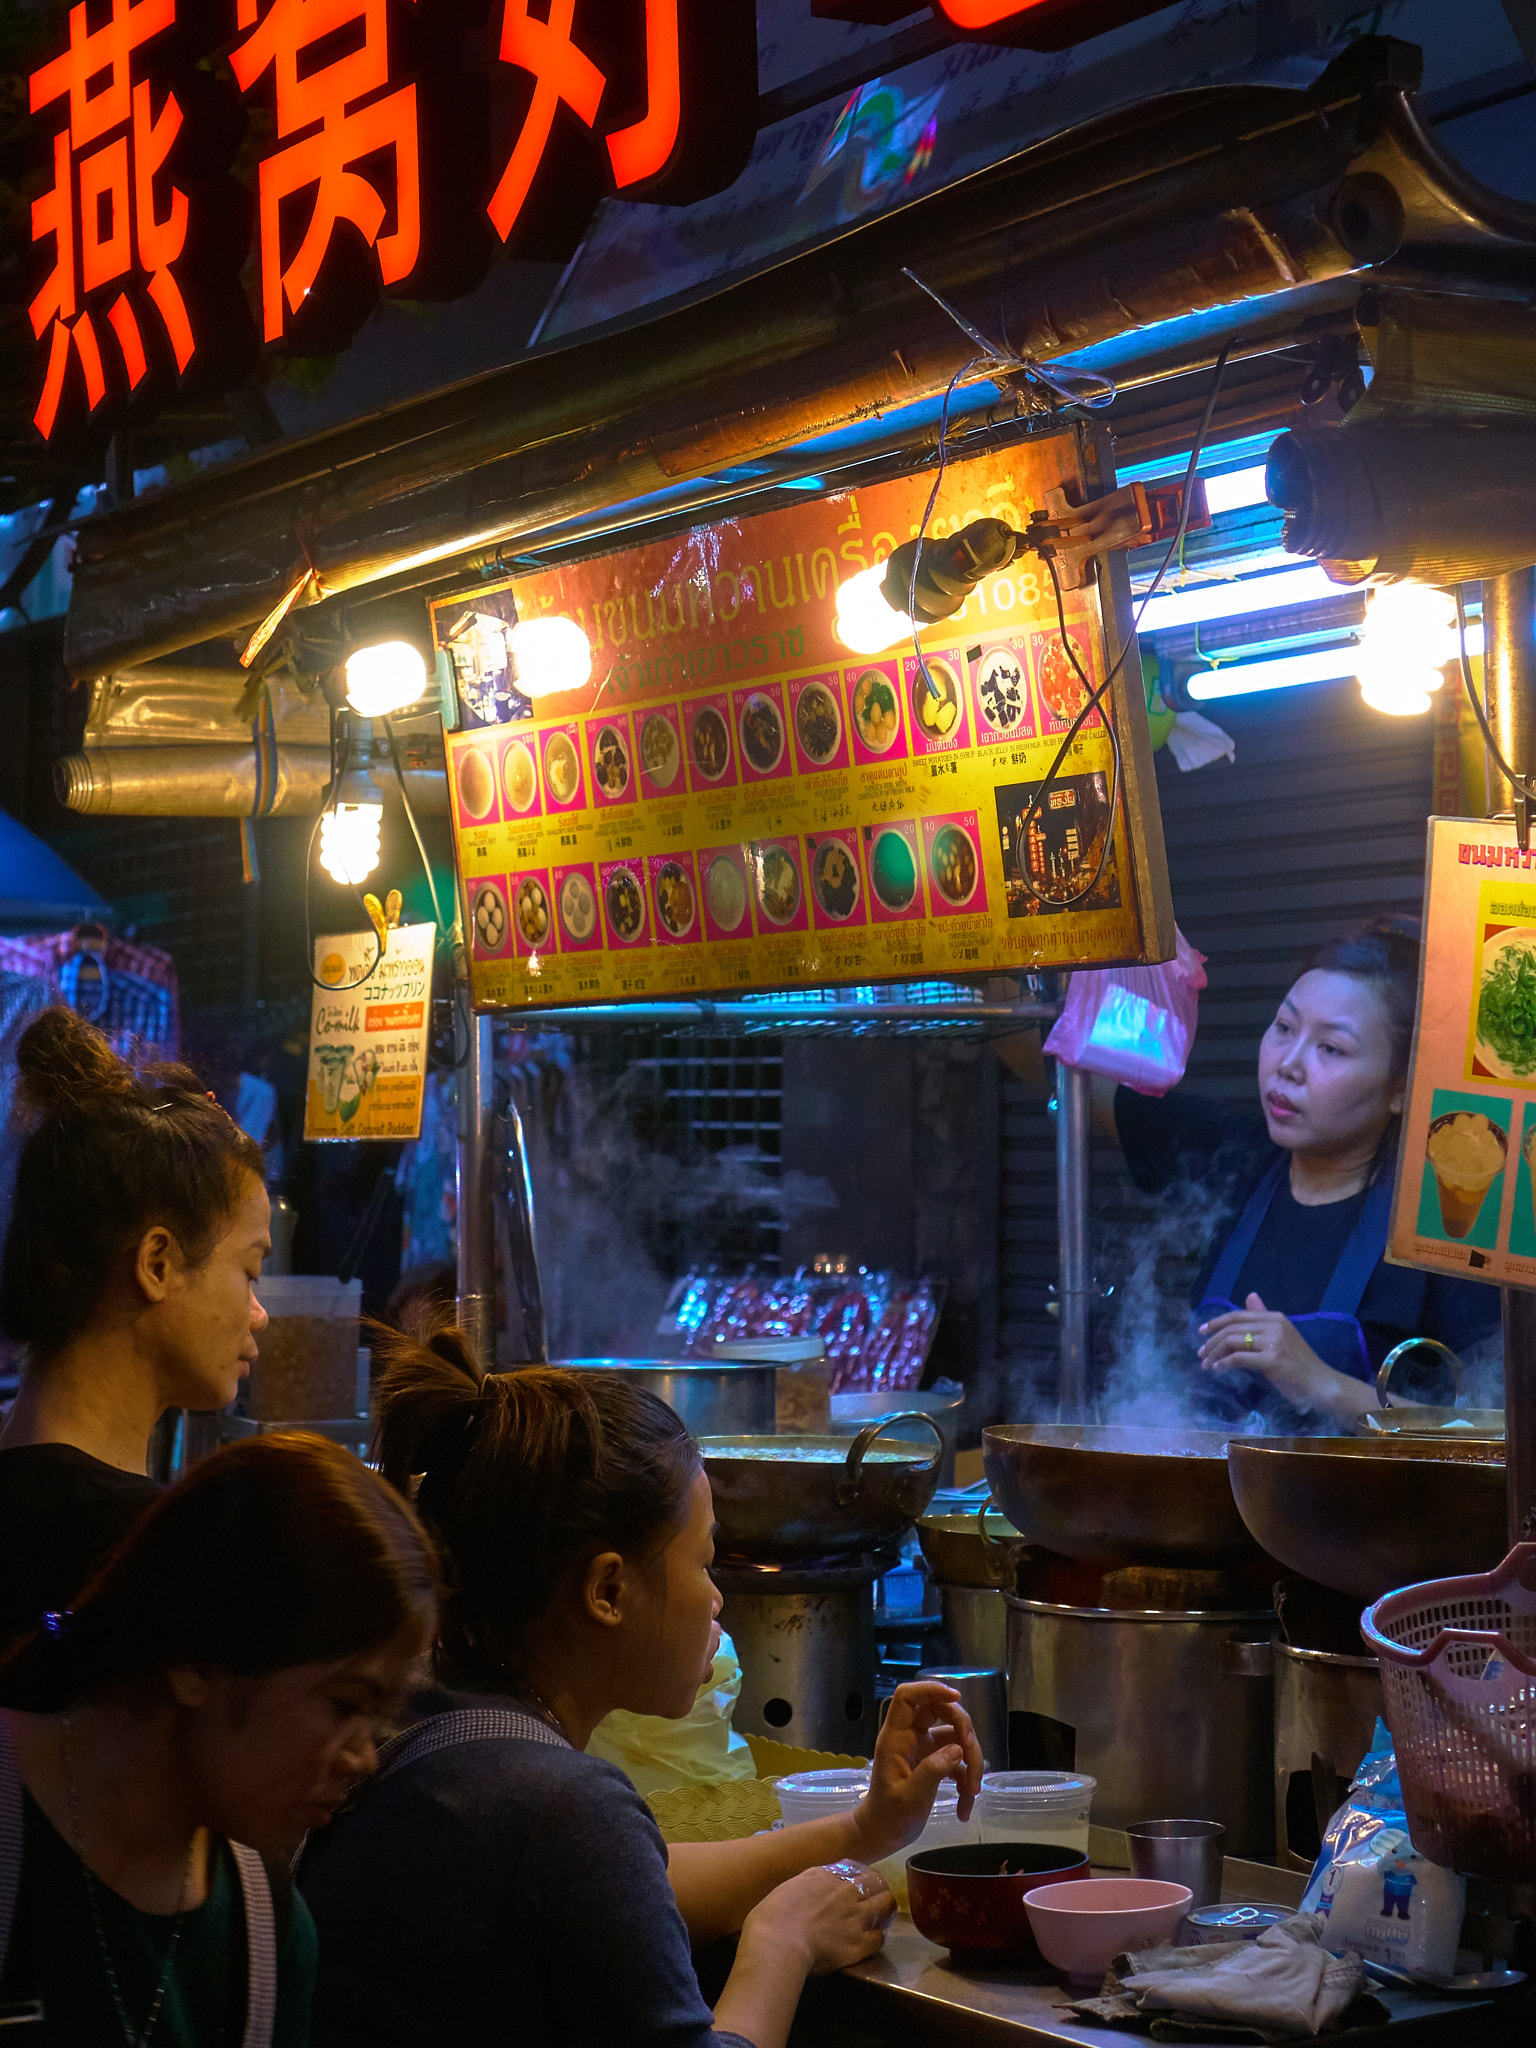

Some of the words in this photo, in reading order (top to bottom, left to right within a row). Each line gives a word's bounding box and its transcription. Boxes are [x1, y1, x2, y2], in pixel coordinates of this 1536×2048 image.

[1011, 637, 1024, 650] 30
[1032, 633, 1044, 647] 30
[948, 650, 960, 662] 30
[905, 660, 915, 672] 20
[845, 671, 857, 682] 40
[923, 821, 935, 833] 40
[963, 816, 975, 827] 50
[904, 824, 915, 835] 20
